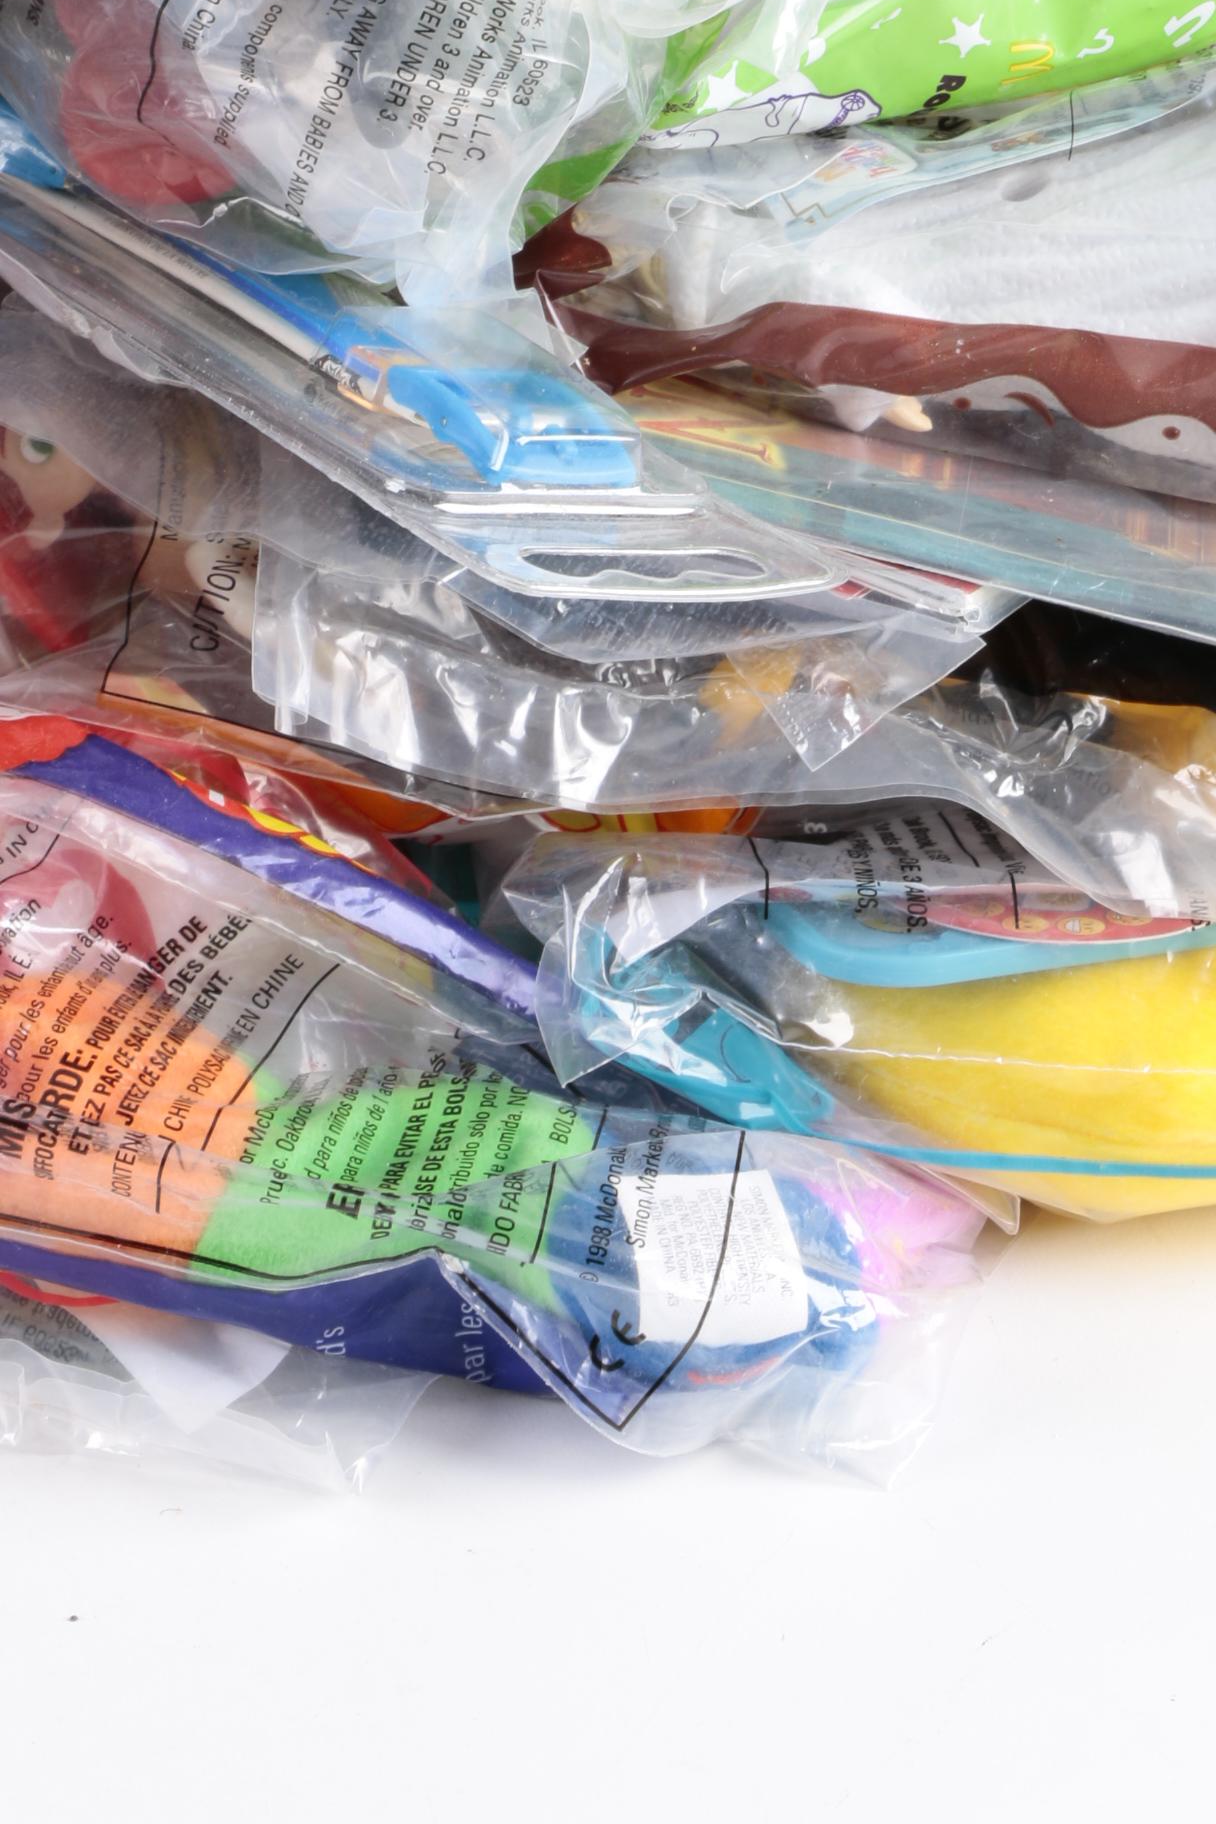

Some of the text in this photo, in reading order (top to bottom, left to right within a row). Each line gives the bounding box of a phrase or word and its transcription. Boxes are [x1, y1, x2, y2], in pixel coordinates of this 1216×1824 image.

[439, 41, 461, 59] 3
[383, 41, 427, 108] UNDER
[424, 56, 452, 92] and
[406, 92, 435, 134] over.
[169, 955, 205, 995] DES
[249, 952, 304, 1011] CHINE
